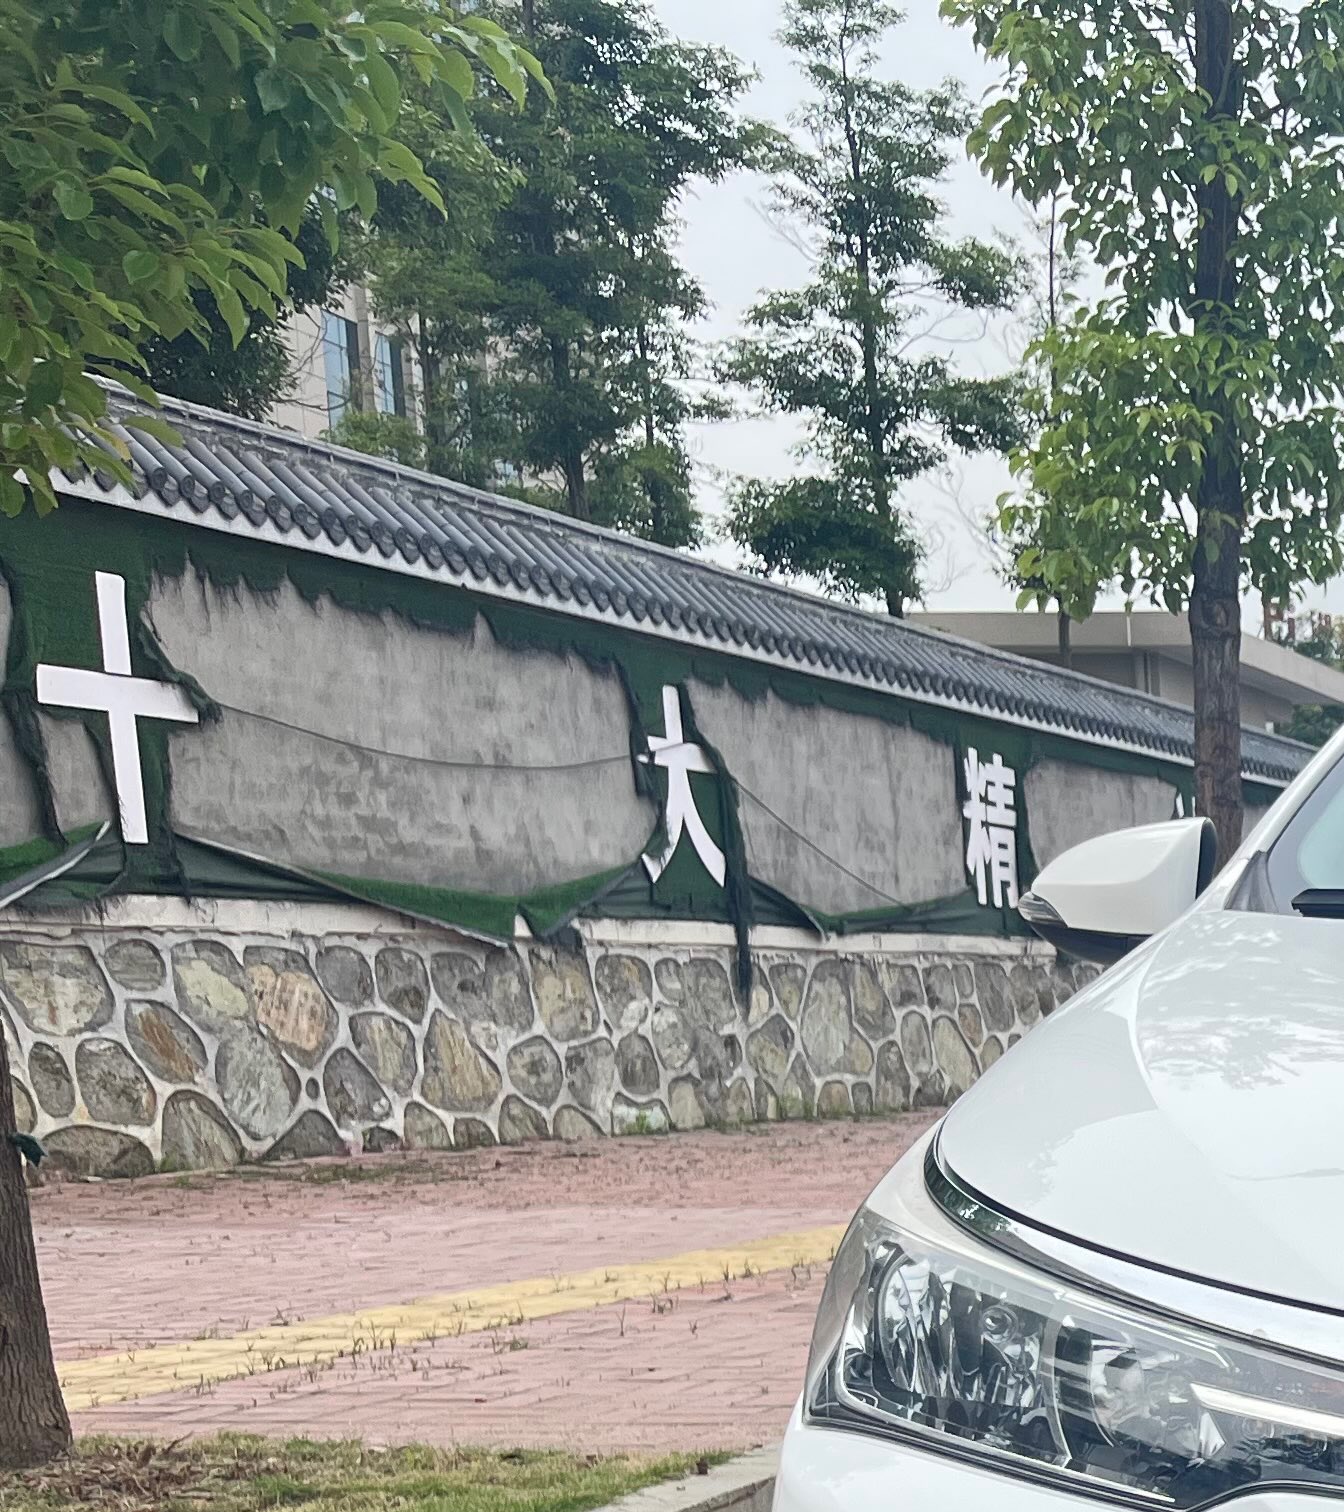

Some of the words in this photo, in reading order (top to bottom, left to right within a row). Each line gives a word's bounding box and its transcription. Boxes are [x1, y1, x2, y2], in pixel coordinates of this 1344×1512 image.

[36, 570, 199, 843] 十
[636, 684, 727, 888] 大
[963, 747, 1019, 909] 精
